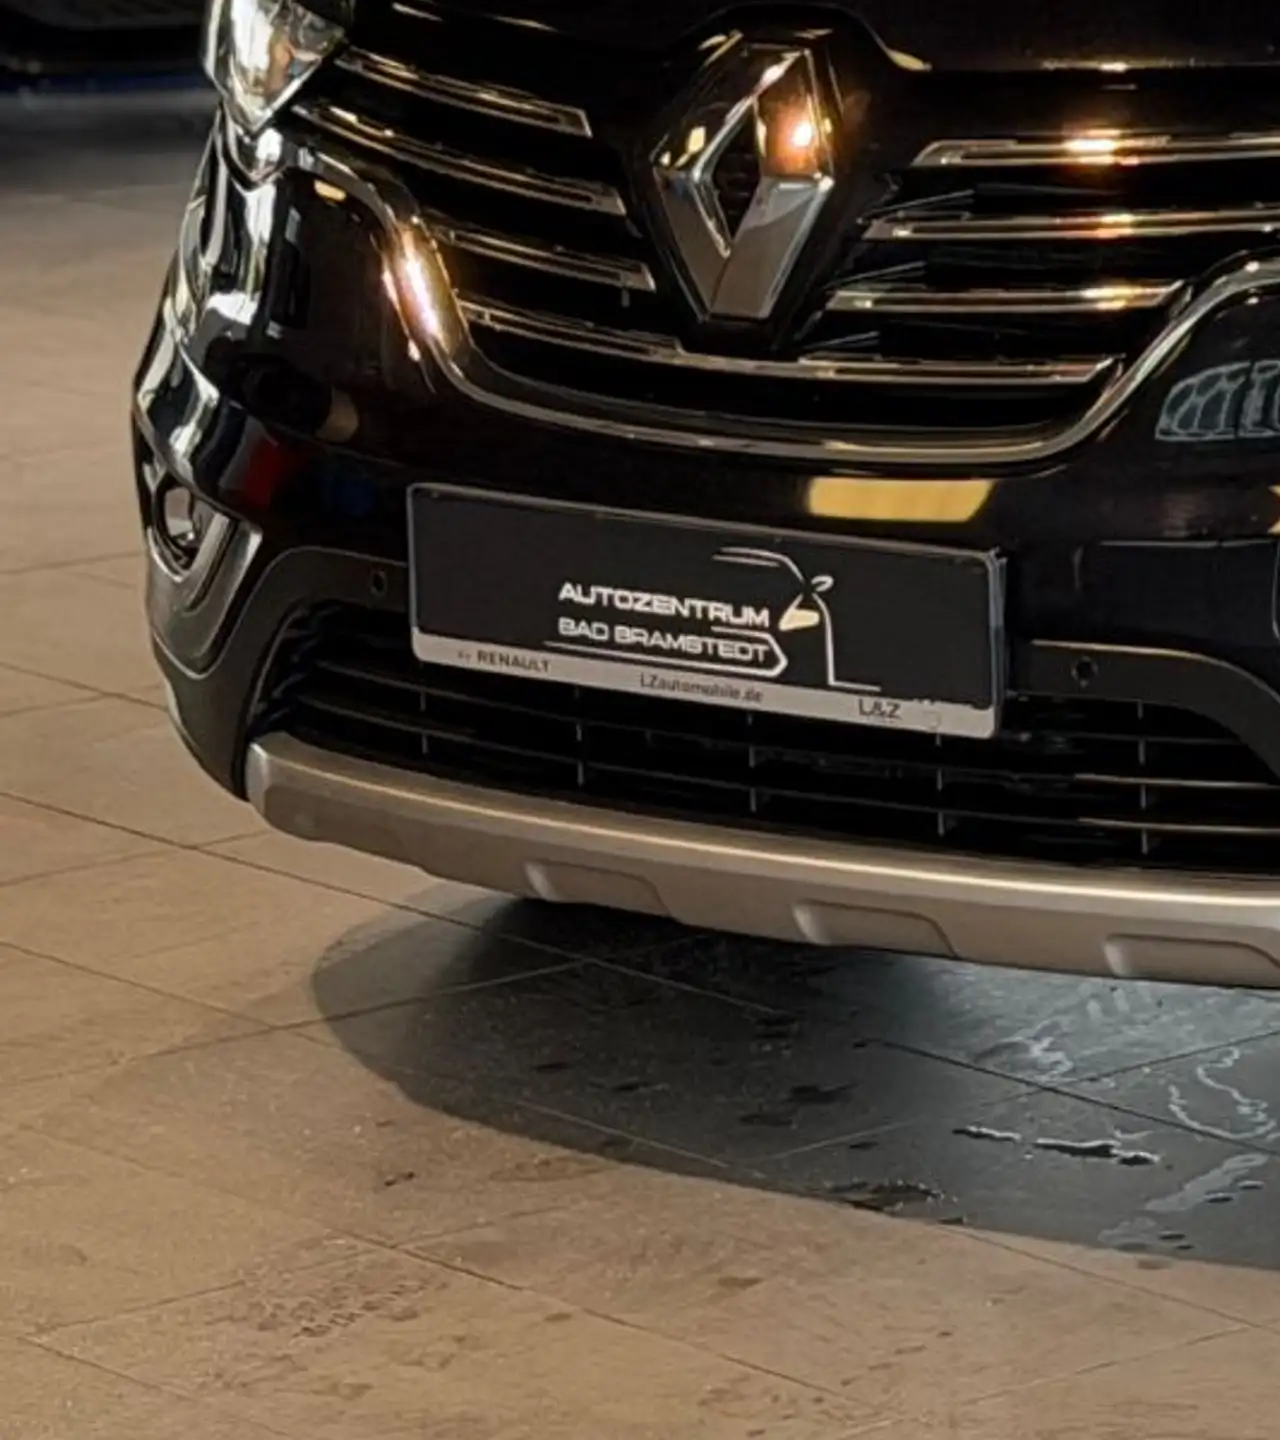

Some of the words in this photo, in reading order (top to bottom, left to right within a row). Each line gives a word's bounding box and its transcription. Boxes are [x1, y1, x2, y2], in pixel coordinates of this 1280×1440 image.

[558, 582, 770, 628] AUTOZENTRUM
[558, 616, 610, 641] BAD
[613, 625, 769, 663] BRAMSTEDT
[477, 649, 550, 673] RENAULT
[640, 671, 764, 703] LZautomobile.de
[858, 697, 903, 721] L&Z
